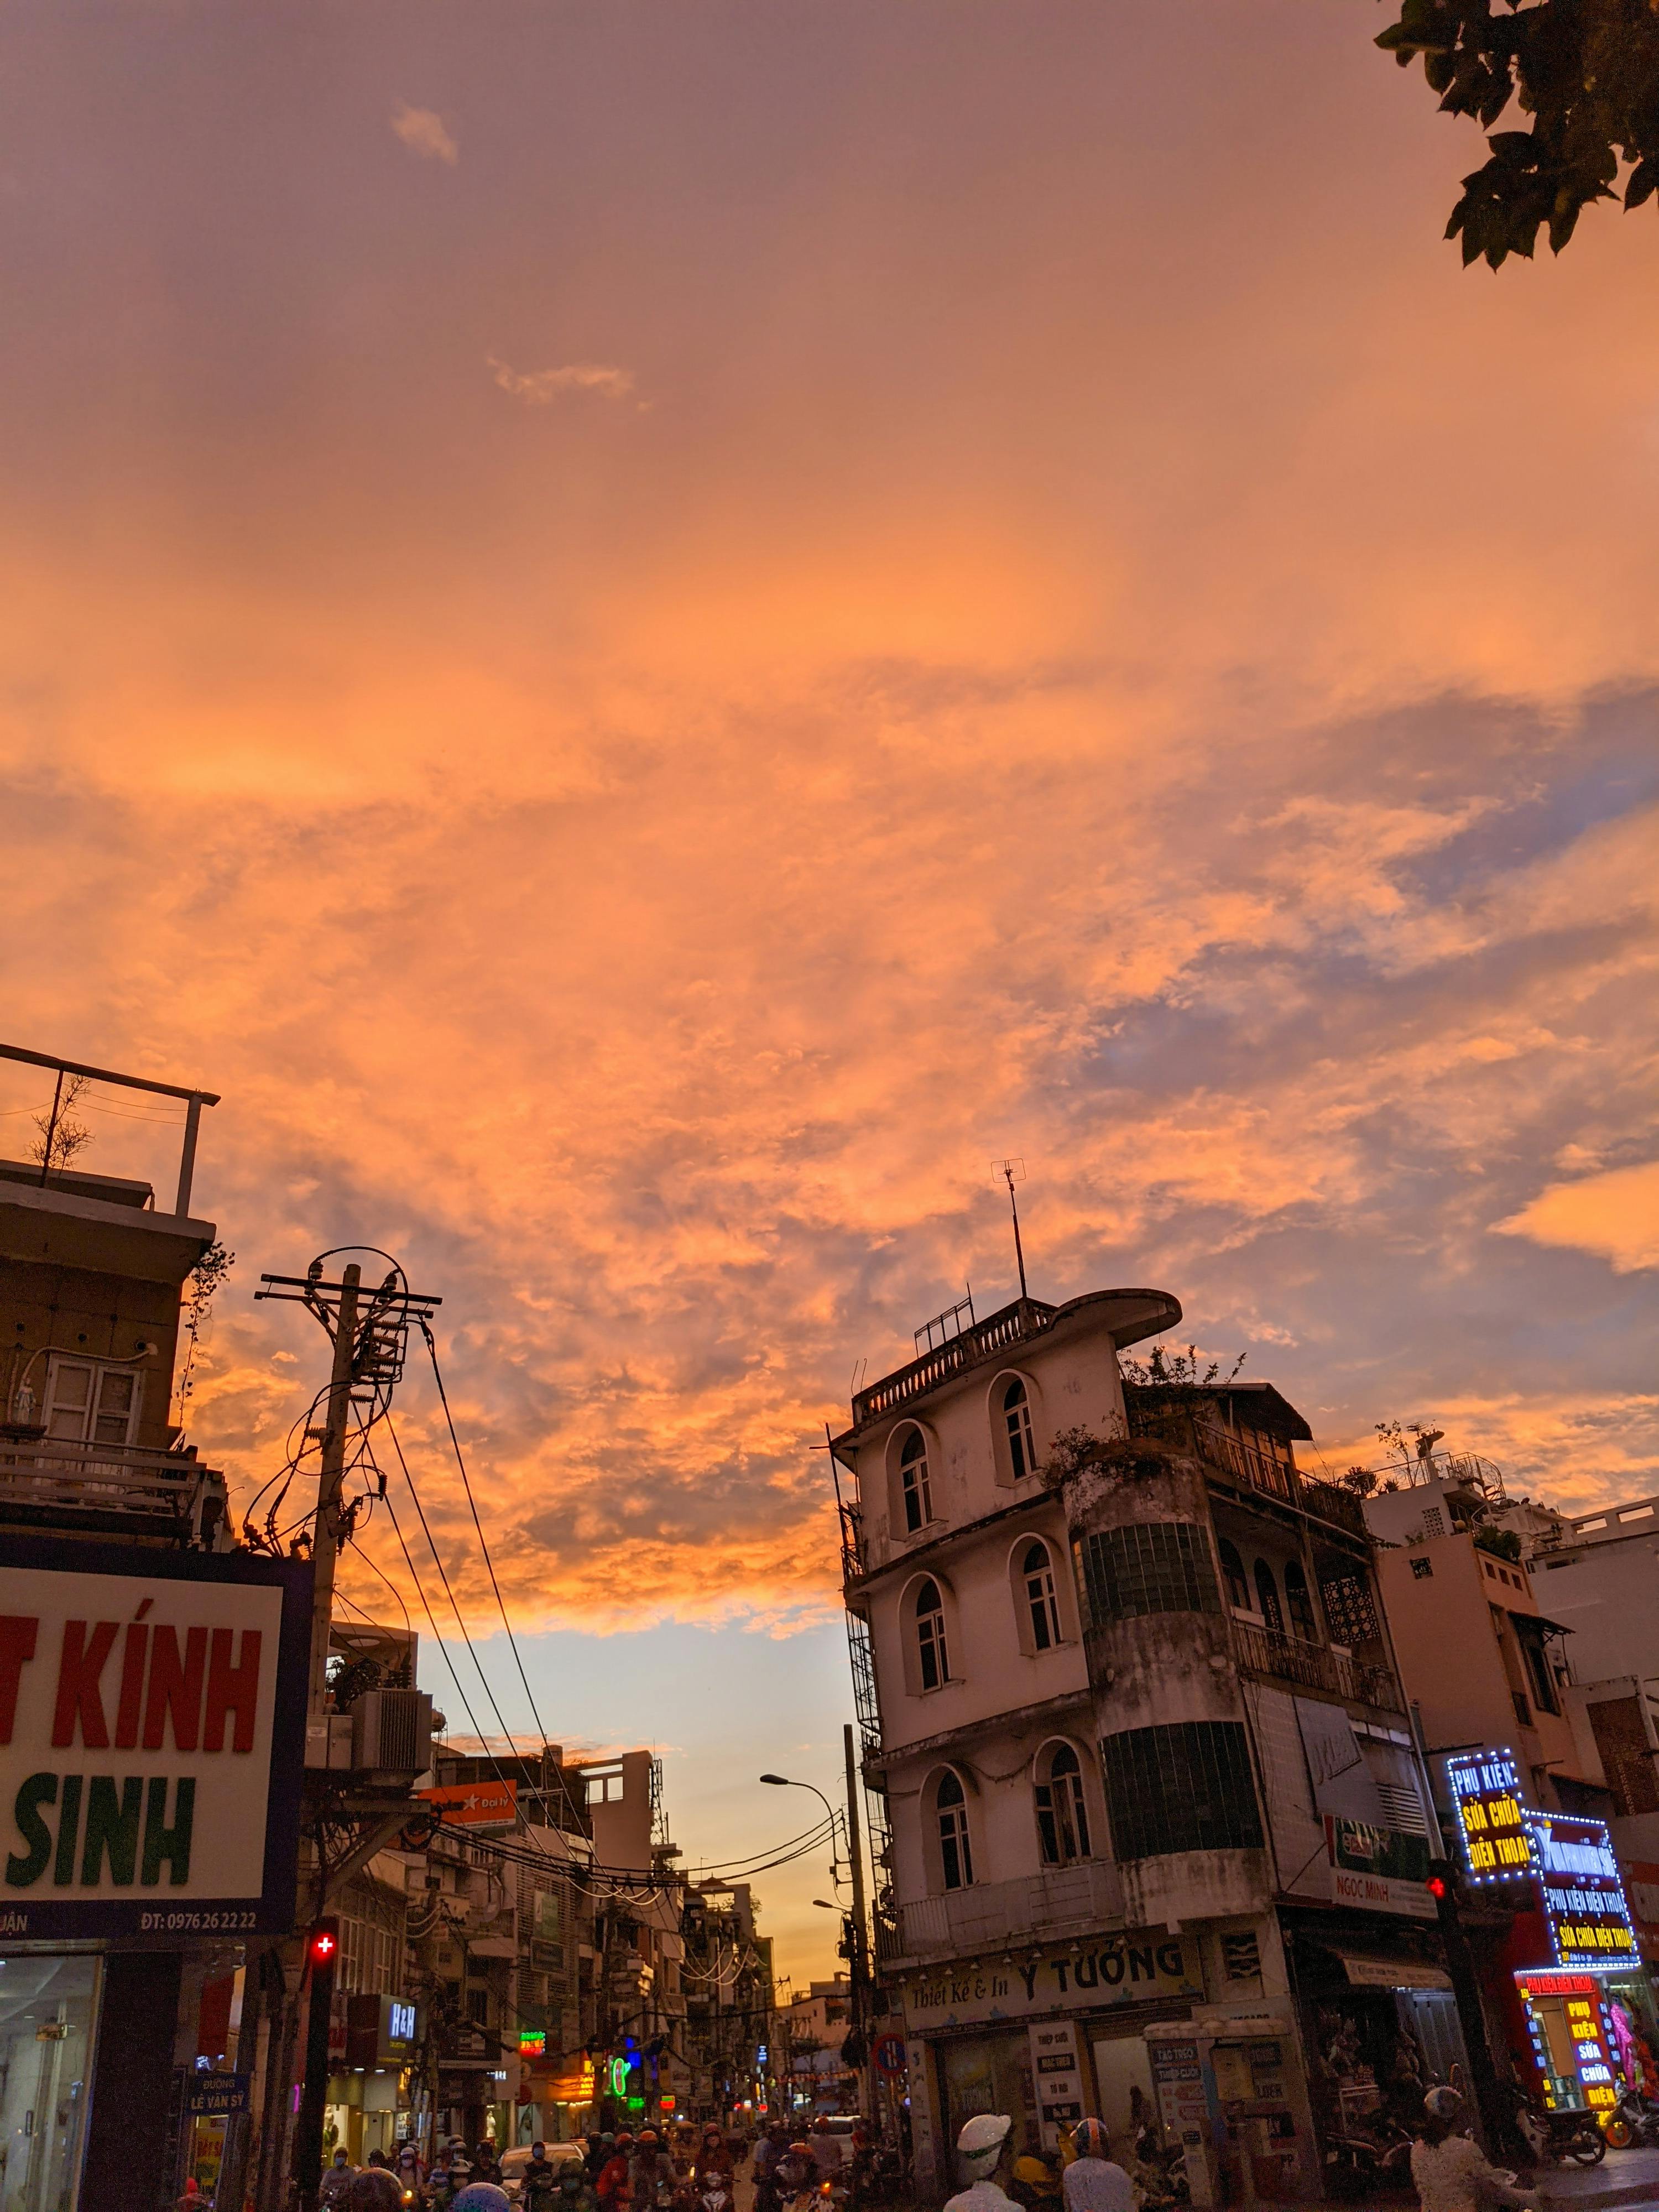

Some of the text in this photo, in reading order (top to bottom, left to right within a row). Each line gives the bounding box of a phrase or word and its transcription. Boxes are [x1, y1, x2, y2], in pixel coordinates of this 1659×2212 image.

[52, 1599, 262, 1752] KÍNH
[1454, 1756, 1514, 1797] PHỤ KIỆN
[1462, 1793, 1522, 1831] SỬA CHỮA
[5, 1773, 196, 1887] SINH
[1495, 1835, 1530, 1868] THOẠI
[1365, 1881, 1389, 1902] MINH
[1548, 1888, 1568, 1917] PHỤ
[1565, 1885, 1587, 1917] KIỆN
[141, 1913, 165, 1929] ĐT:
[168, 1913, 201, 1929] 0976
[203, 1912, 220, 1928] 26
[1559, 1919, 1577, 1947] SỬA
[1575, 1922, 1597, 1947] CHỮA
[914, 1940, 1184, 2008] Thiết Kế & In Ý TƯỞNG
[1526, 1977, 1542, 1994] PHỤ
[392, 2003, 415, 2039] H&H
[1568, 2001, 1590, 2018] PHỤ
[1572, 2021, 1598, 2039] KIỆN
[1578, 2041, 1601, 2059] SỬA
[1581, 2064, 1611, 2081] CHỮA
[190, 2093, 204, 2110] LÊ
[207, 2093, 229, 2109] VĂN
